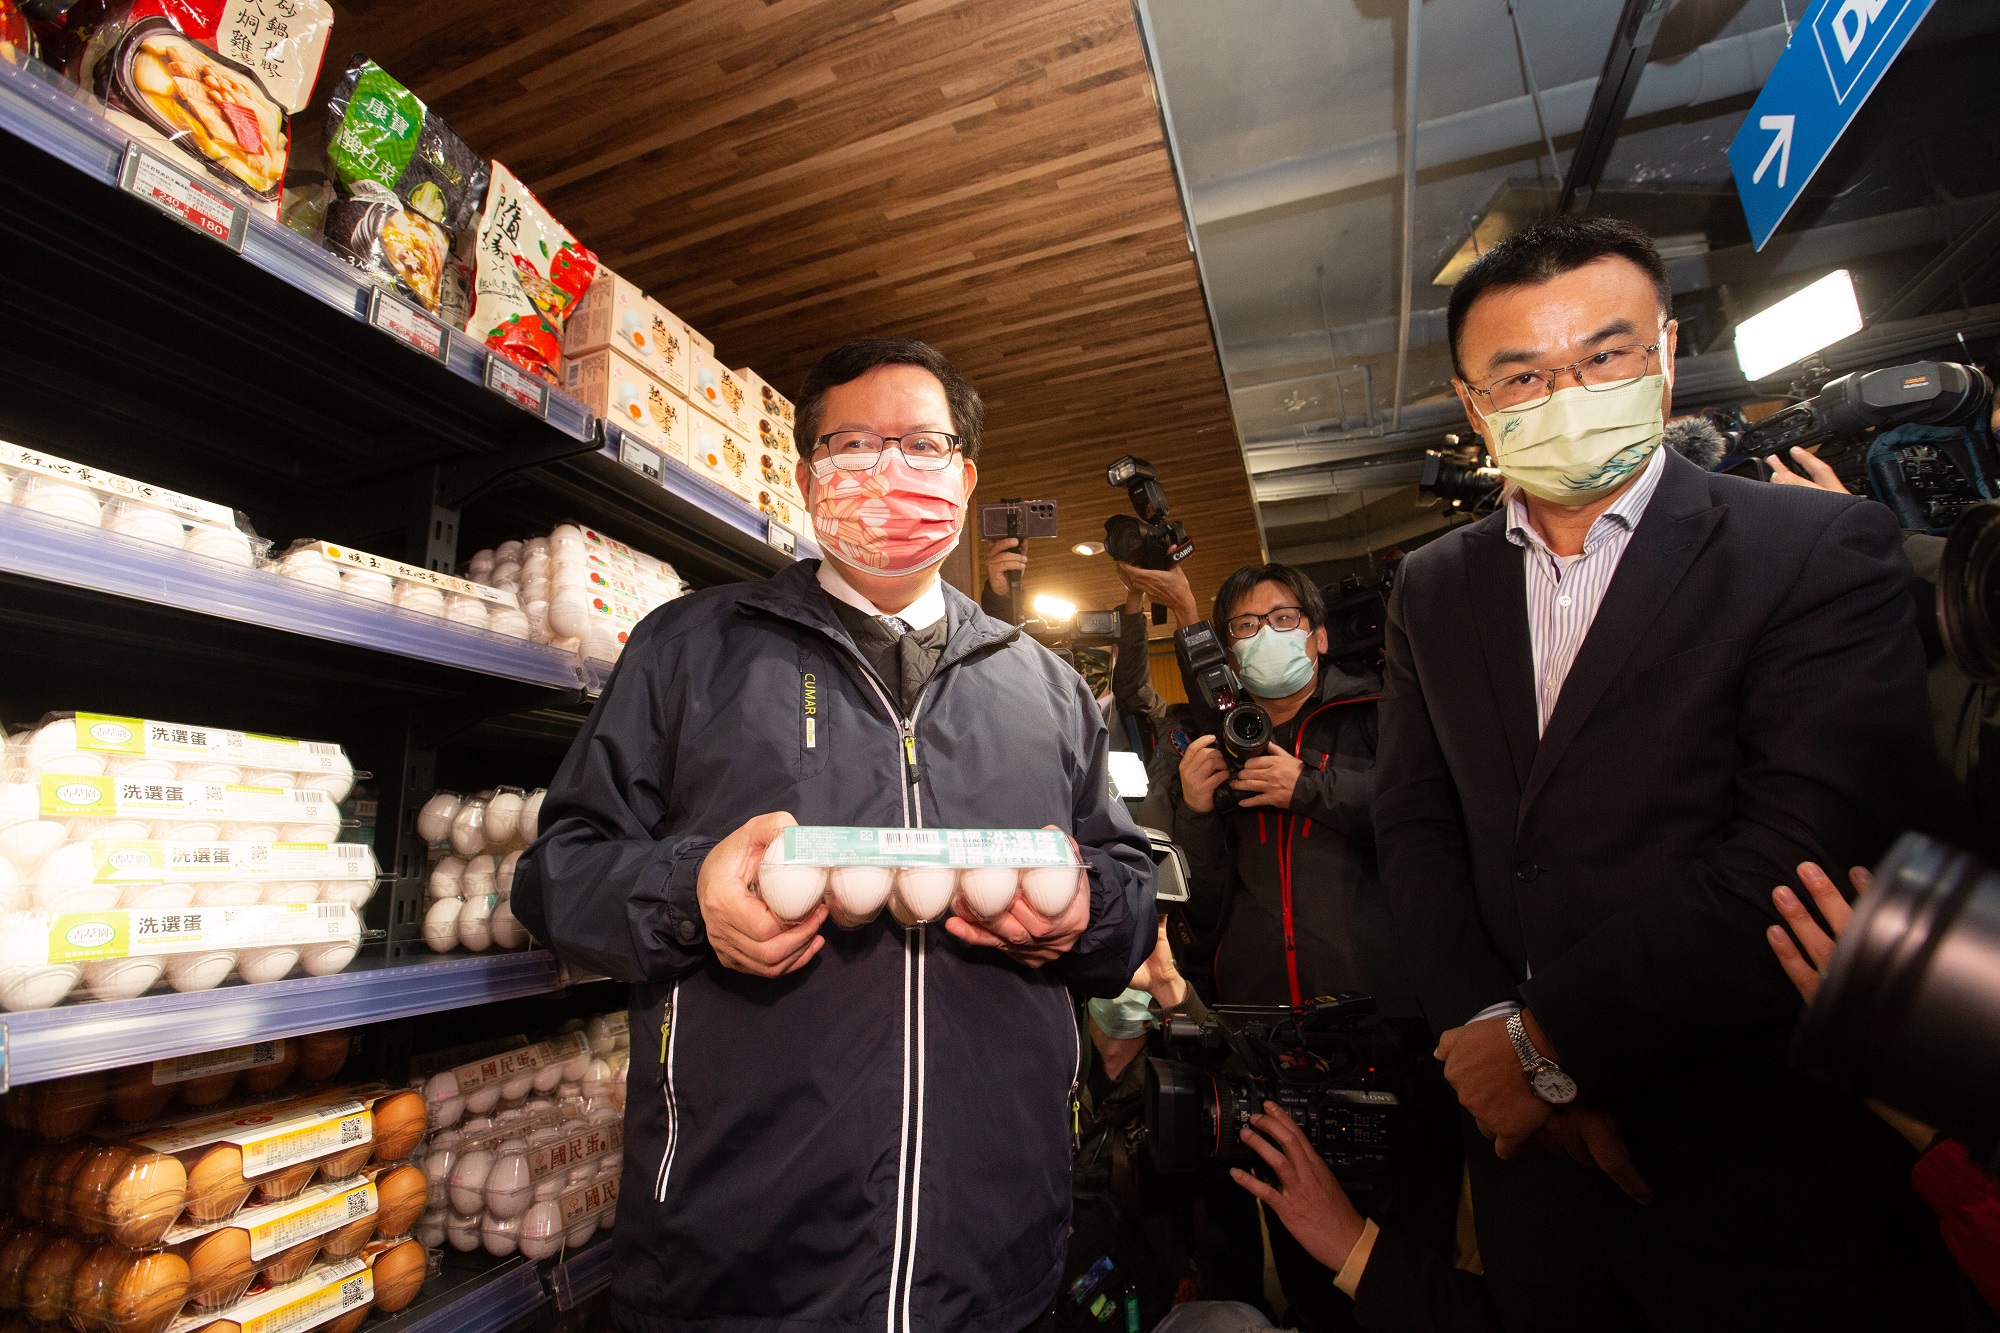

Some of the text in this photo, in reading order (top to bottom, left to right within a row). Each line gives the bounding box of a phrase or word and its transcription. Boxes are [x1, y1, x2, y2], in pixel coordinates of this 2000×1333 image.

[366, 97, 410, 140] 康寶
[337, 129, 399, 186] 酸白菜
[158, 191, 180, 207] 240
[199, 217, 224, 235] 180
[420, 340, 435, 353] 149
[20, 452, 96, 482] 紅心蛋
[1172, 544, 1194, 561] Canon
[804, 673, 816, 715] CUMAR
[152, 726, 208, 746] 洗選蛋
[123, 784, 184, 801] 洗選蛋
[172, 847, 231, 864] 洗選蛋
[138, 914, 203, 934] 洗選蛋
[481, 1051, 531, 1082] 國民蛋
[1361, 1094, 1393, 1102] SONY
[551, 1132, 601, 1169] 國民蛋
[585, 1177, 621, 1212] 國民
